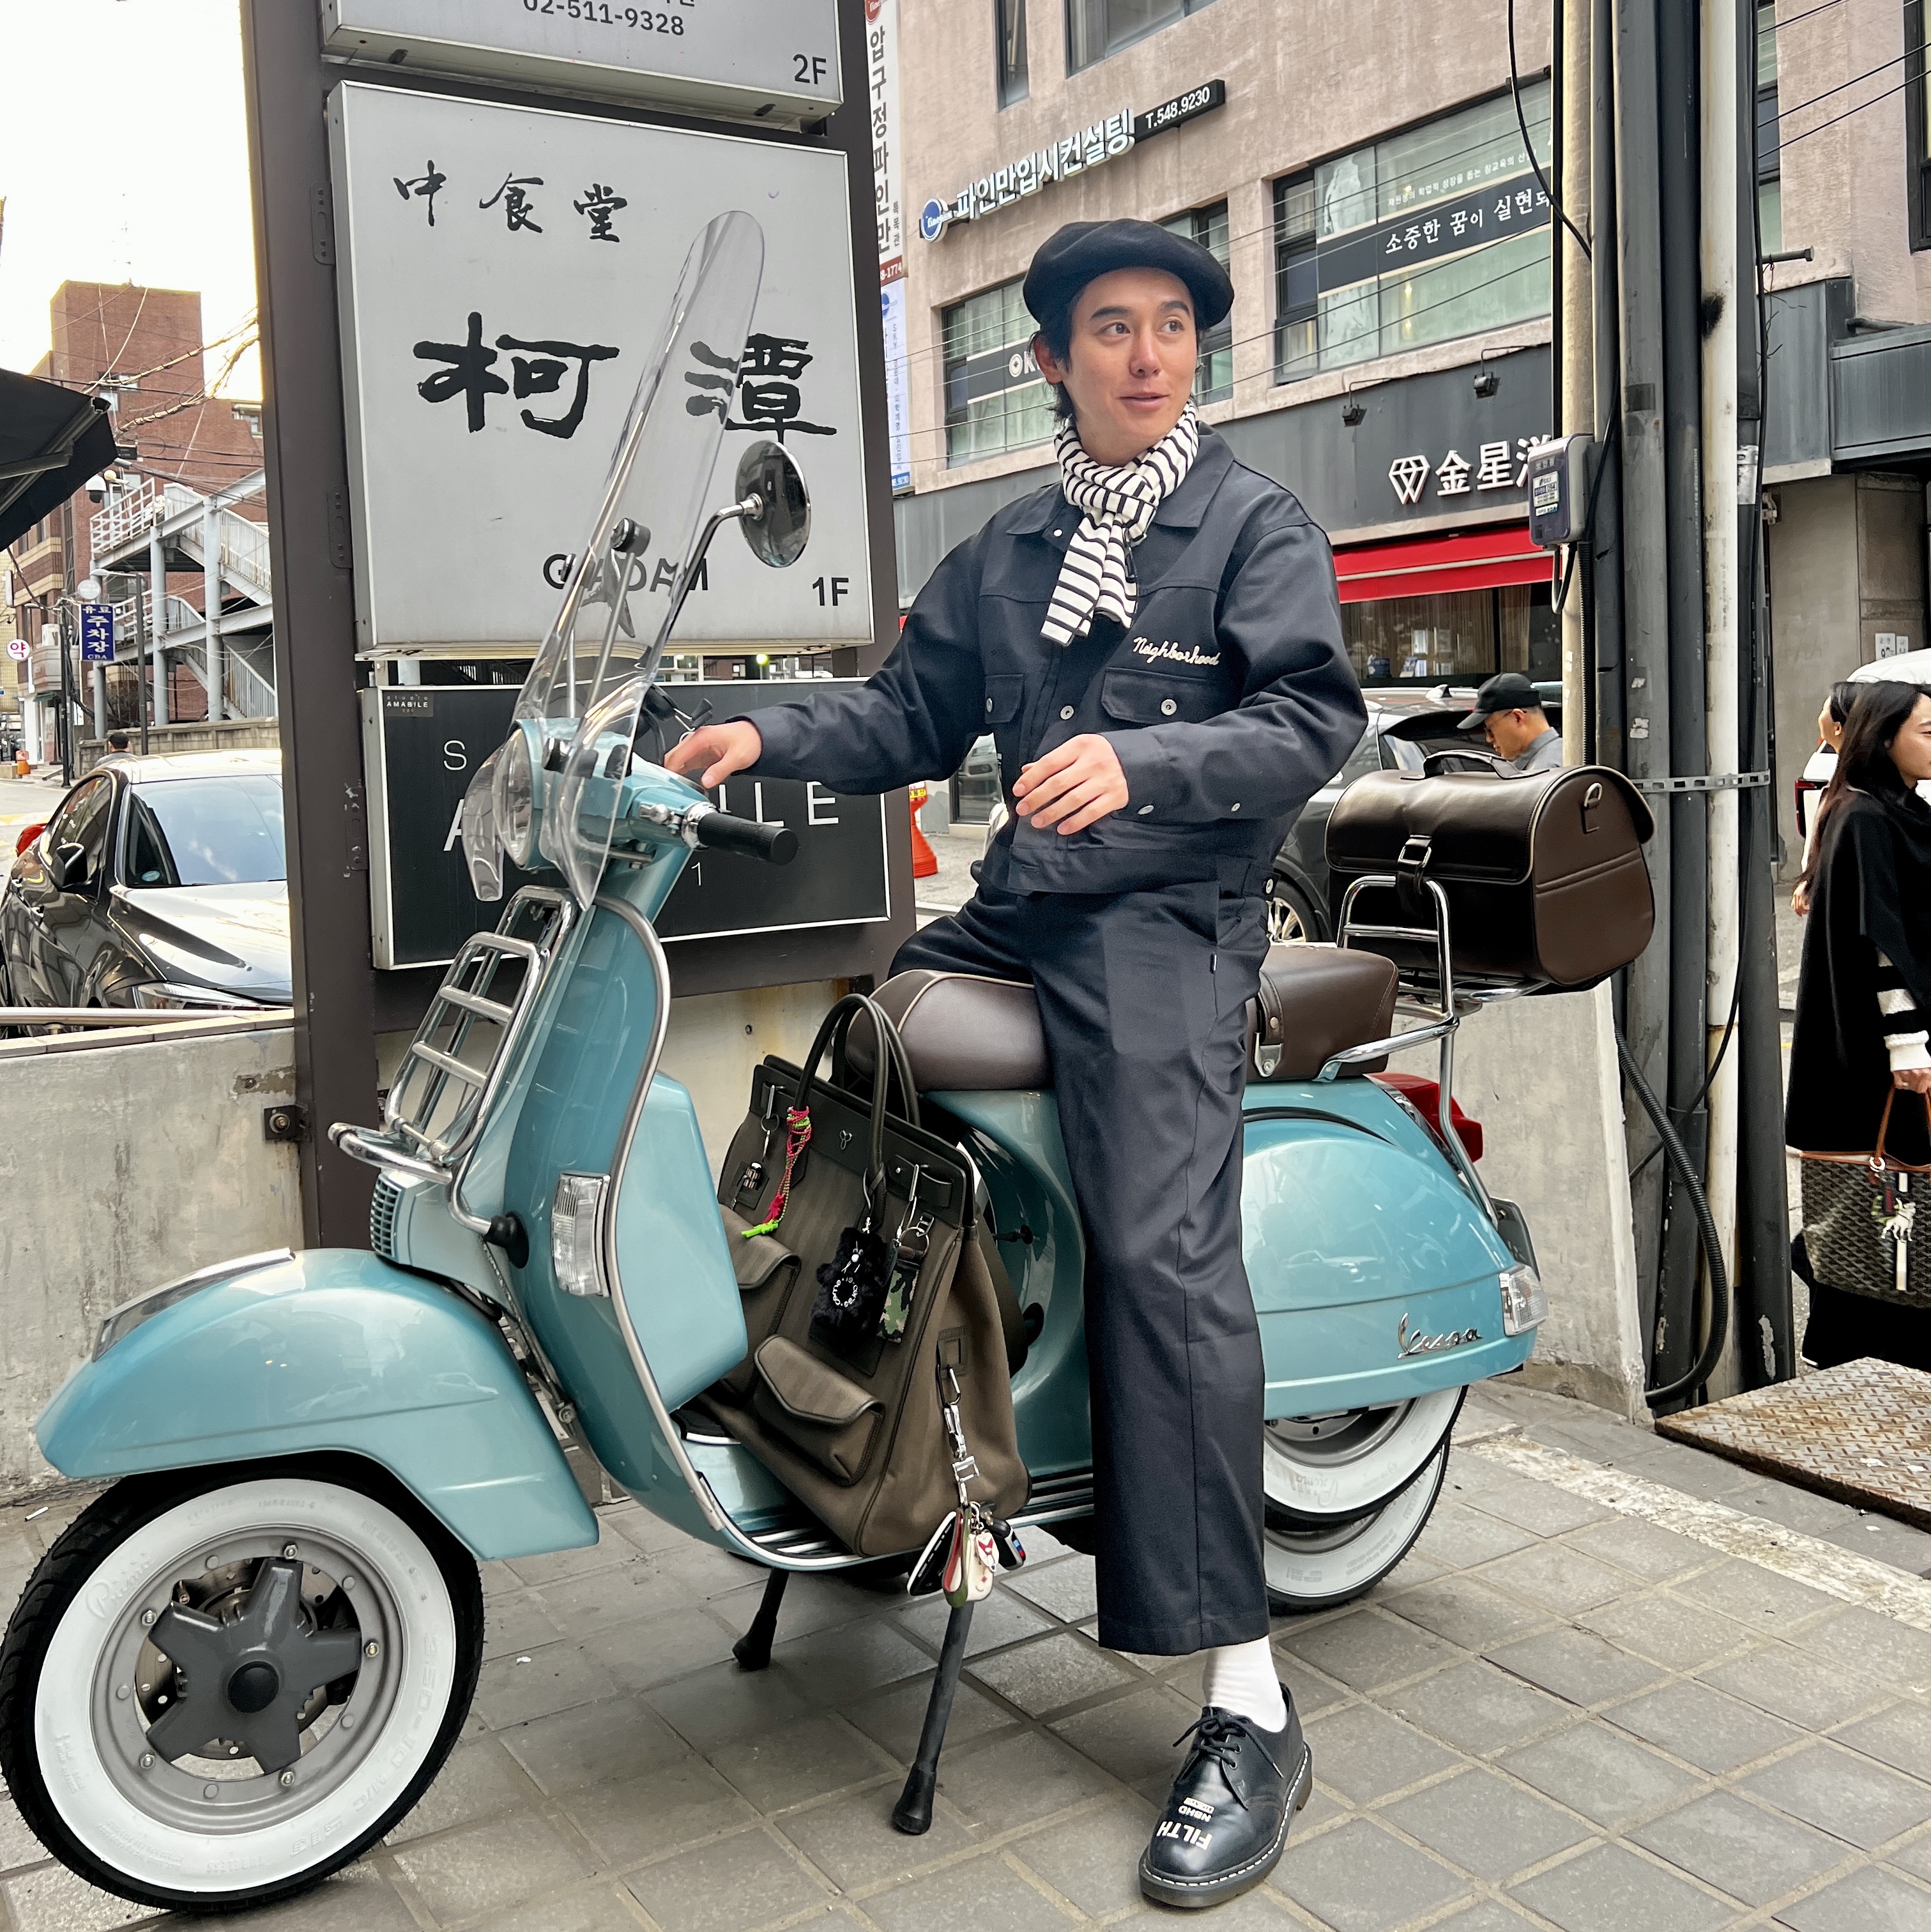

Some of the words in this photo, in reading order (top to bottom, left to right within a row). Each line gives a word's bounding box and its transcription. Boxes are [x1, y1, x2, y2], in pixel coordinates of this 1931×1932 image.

[523, 0, 684, 36] 02-511-9328
[793, 54, 827, 85] 2F
[1145, 86, 1210, 128] T.548.9230
[870, 25, 892, 254] 압구정파인만
[956, 109, 1134, 220] 파인만입시컨설팅
[393, 159, 628, 243] 中食堂
[1385, 218, 1441, 254] 소중한
[1449, 209, 1483, 236] 꿈이
[812, 577, 850, 607] 1F
[10, 642, 27, 658] 약
[86, 615, 111, 653] 주차장
[1133, 636, 1221, 666] Neighborhood
[1397, 1312, 1484, 1360] Vespa
[1178, 1805, 1212, 1822] NBHD
[1156, 1821, 1213, 1851] FILTH
